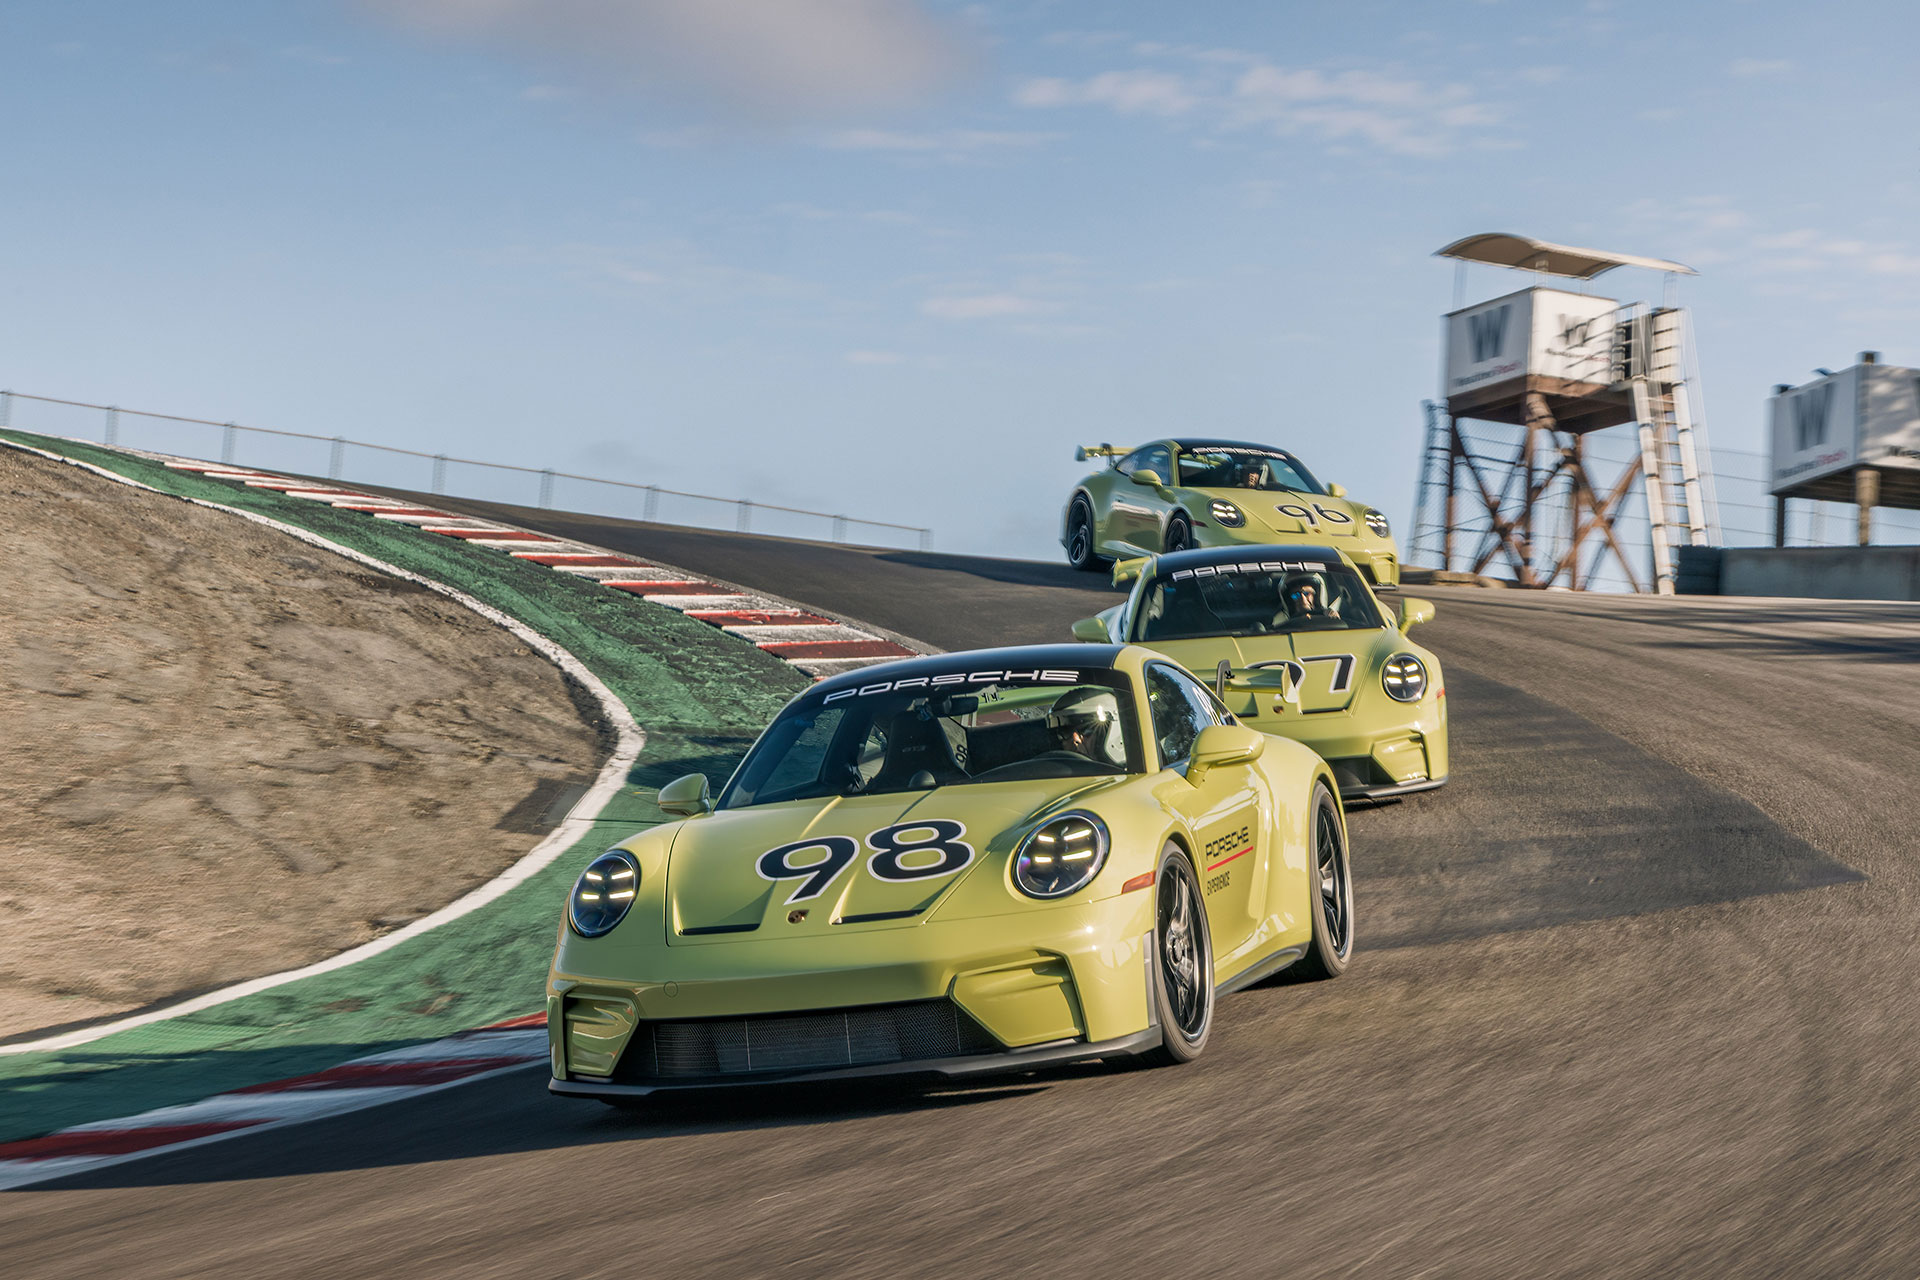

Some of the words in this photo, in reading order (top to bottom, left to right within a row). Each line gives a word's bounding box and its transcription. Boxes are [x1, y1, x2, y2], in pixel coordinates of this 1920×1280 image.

[1192, 447, 1288, 460] PORSCHE
[1274, 504, 1354, 527] 96
[1172, 562, 1327, 582] PORSCHE
[823, 670, 1080, 705] PORSCHE
[1206, 826, 1249, 861] PORSCHE
[755, 819, 976, 906] 98
[1207, 871, 1230, 896] EXPERIENCE
